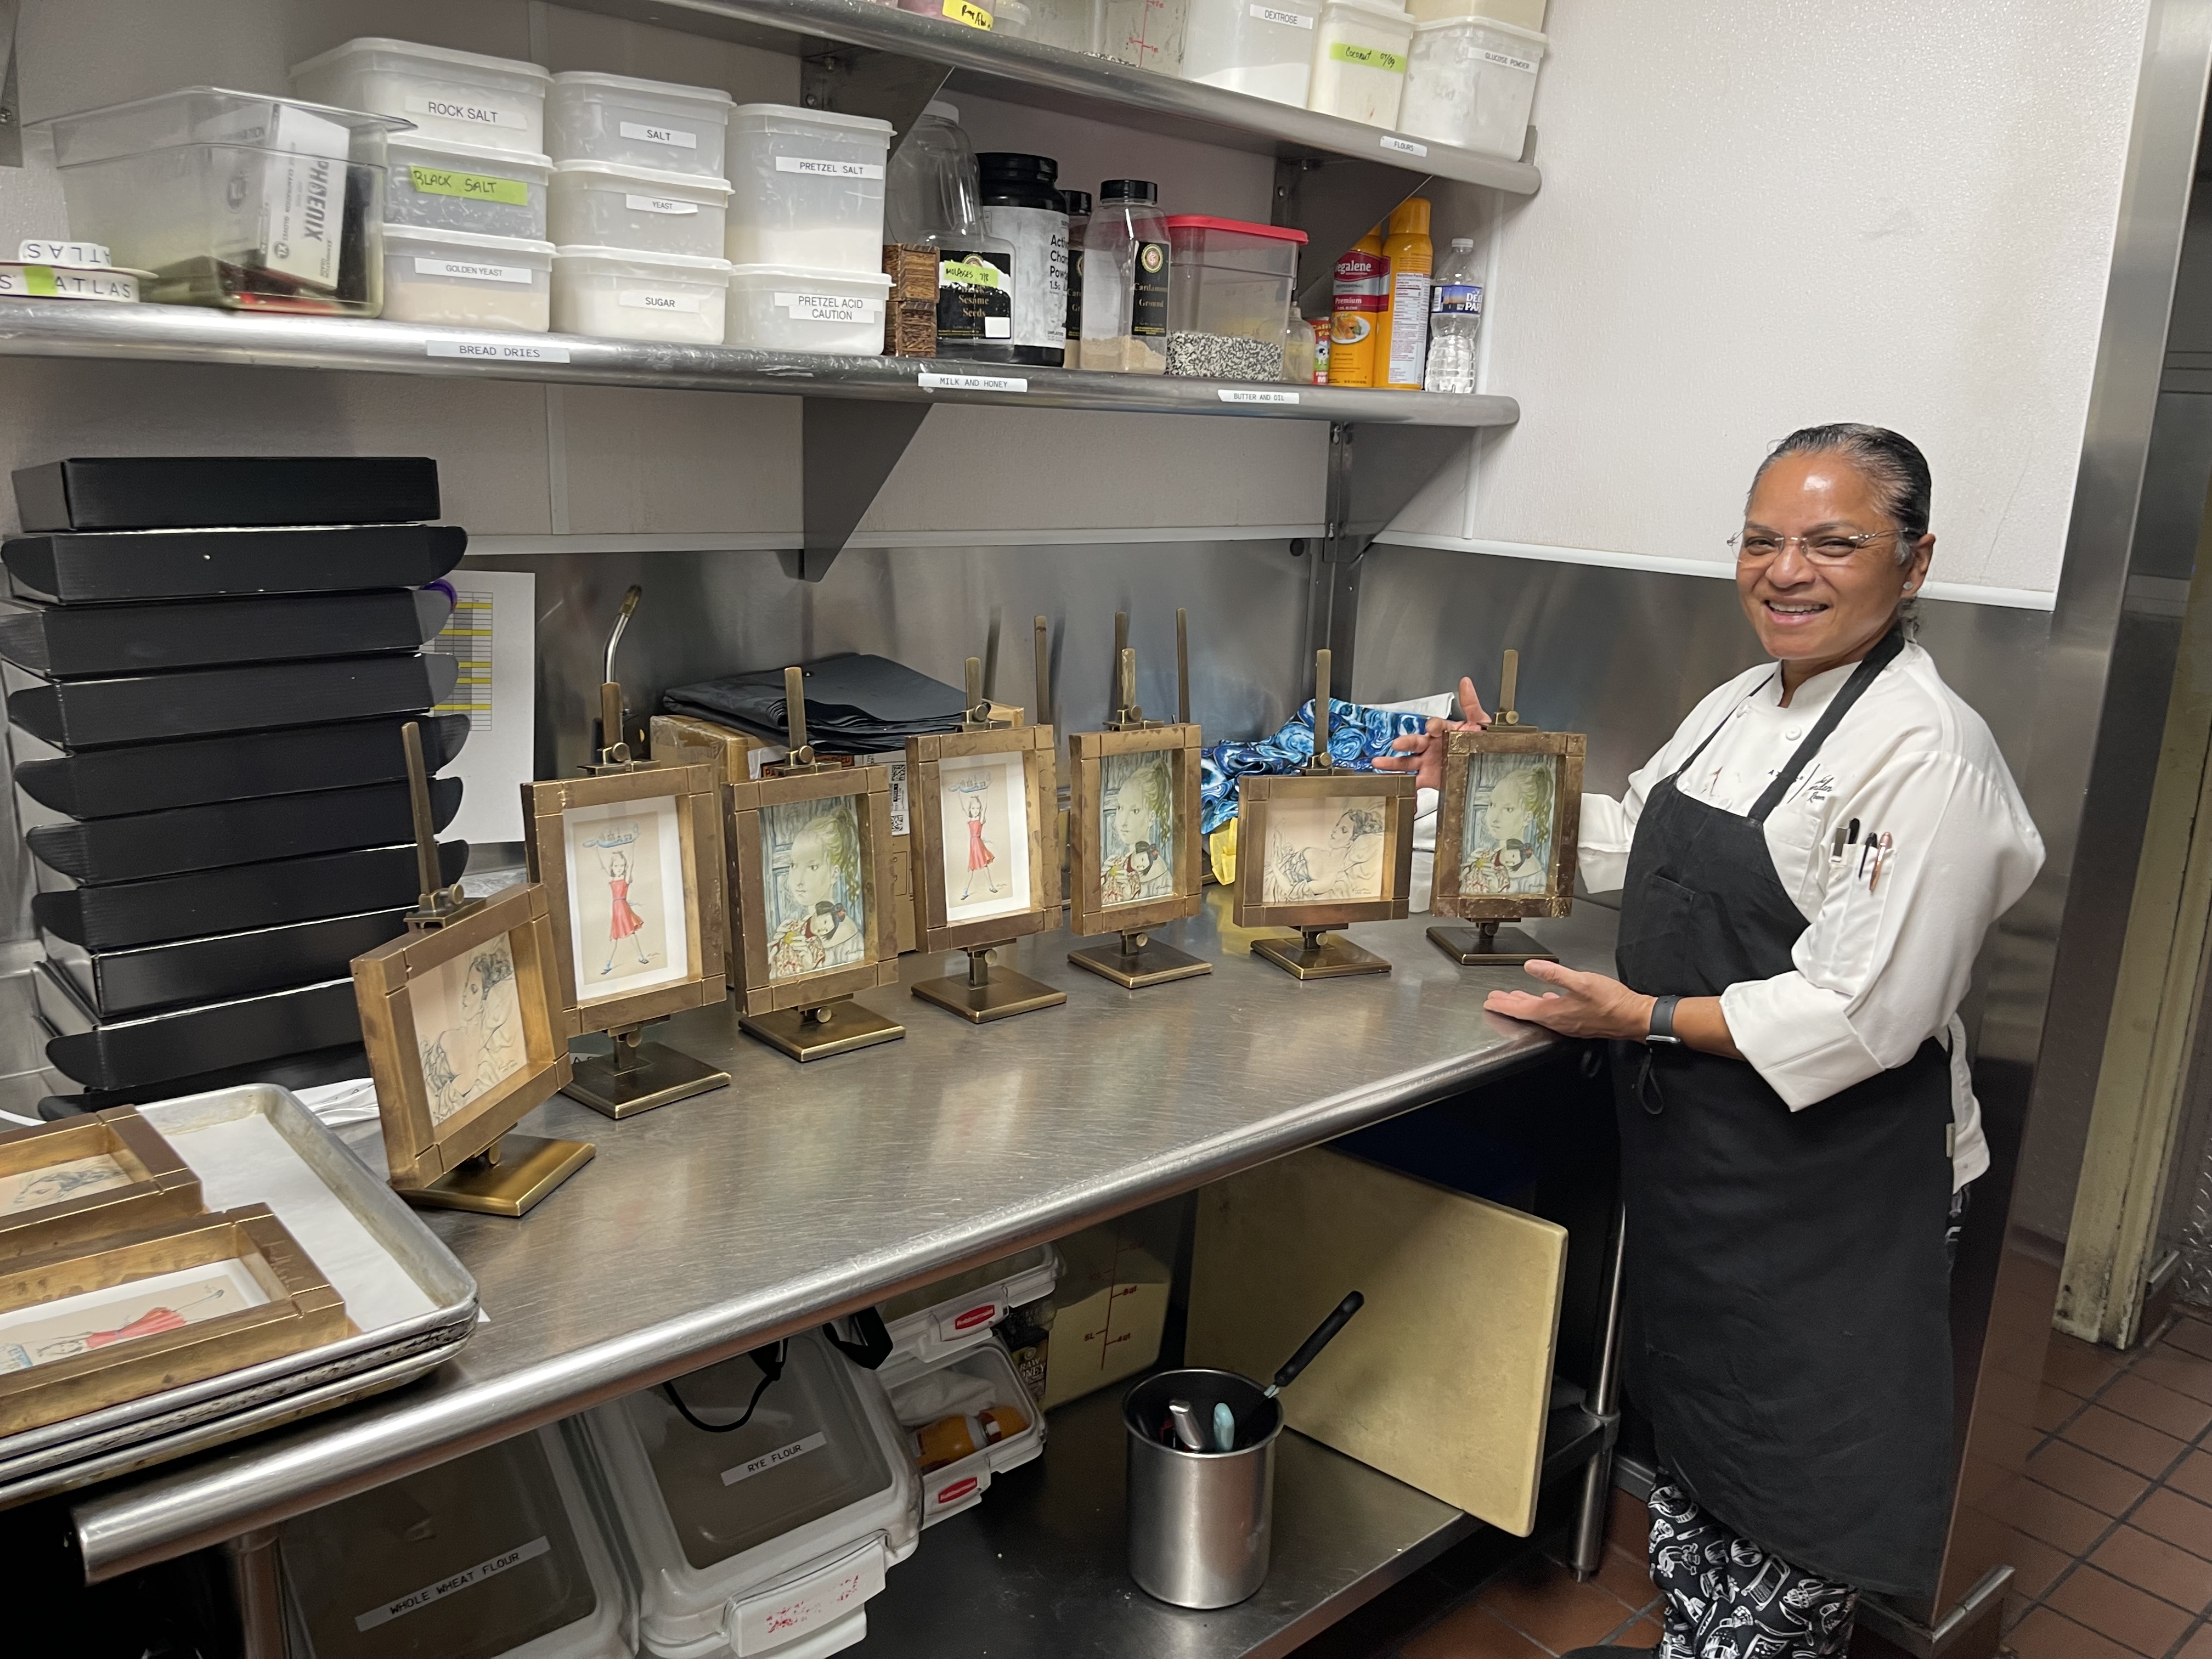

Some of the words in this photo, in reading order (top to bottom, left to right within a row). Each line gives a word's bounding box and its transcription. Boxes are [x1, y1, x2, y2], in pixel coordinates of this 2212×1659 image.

[1265, 10, 1298, 25] DEXTROSE
[1485, 52, 1508, 64] GLUCOSE
[1510, 59, 1530, 69] POWDER
[428, 101, 465, 119] ROCK
[467, 107, 499, 123] SALT
[646, 129, 672, 142] SALT
[1393, 140, 1414, 152] FLOURS
[799, 161, 838, 173] PRETZEL
[843, 165, 864, 176] SALT
[413, 170, 453, 188] BLACK
[464, 179, 497, 194] SALT
[652, 201, 674, 210] YEAST
[445, 264, 478, 274] GOLDEN
[479, 267, 503, 277] YEAST
[55, 275, 131, 298] ATLAS
[645, 297, 675, 308] SUGAR
[798, 296, 839, 308] PRETZEL
[842, 298, 864, 309] ACID
[958, 294, 989, 305] Sesame
[812, 309, 853, 321] CAUTION
[962, 307, 986, 317] Seeds
[459, 345, 497, 356] BREAD
[504, 348, 541, 358] DRIES
[939, 377, 960, 386] MILK
[1084, 1332, 1095, 1342] 5L
[1019, 1357, 1041, 1372] RAW
[747, 1459, 767, 1472] RYE
[771, 1444, 802, 1463] FLOUR
[389, 1590, 431, 1615] WHOLE
[436, 1571, 474, 1594] WHEAT
[482, 1552, 520, 1576] FLOUR
